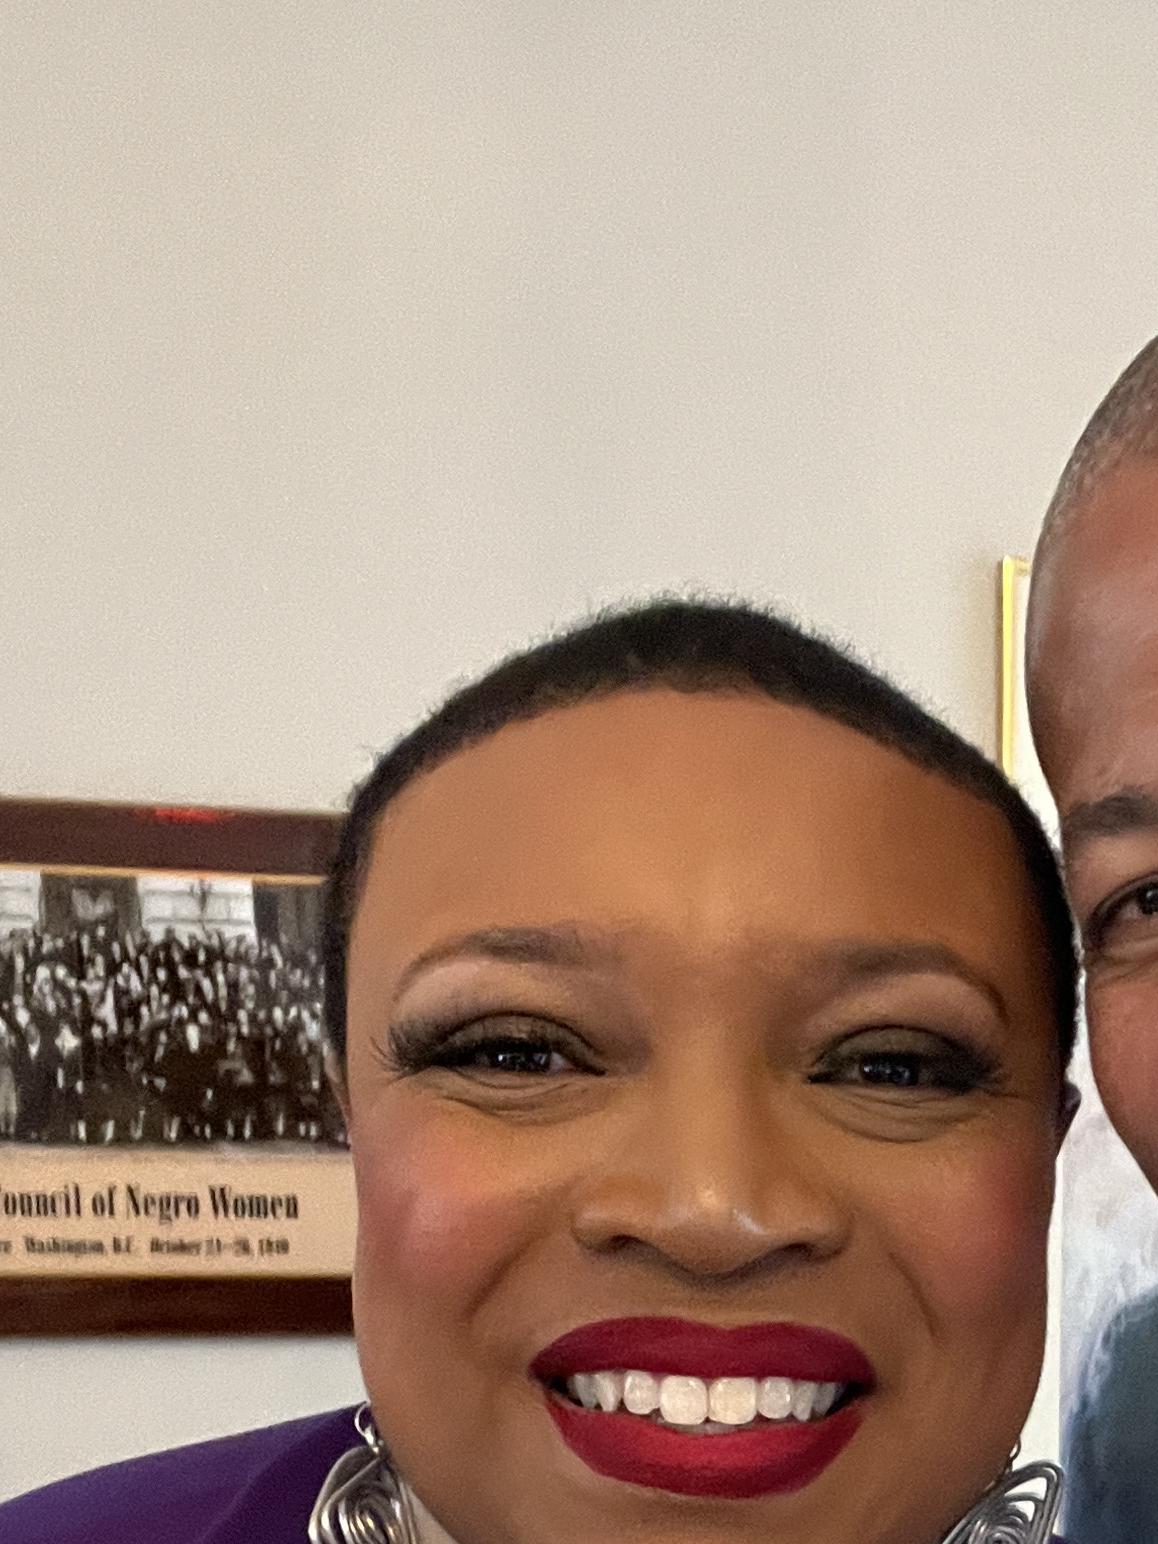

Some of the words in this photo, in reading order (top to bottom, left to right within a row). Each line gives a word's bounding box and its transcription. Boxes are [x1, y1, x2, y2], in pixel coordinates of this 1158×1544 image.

[0, 1182, 82, 1218] ouncil
[91, 1184, 116, 1218] of
[126, 1183, 200, 1225] Negro
[208, 1184, 299, 1219] Women
